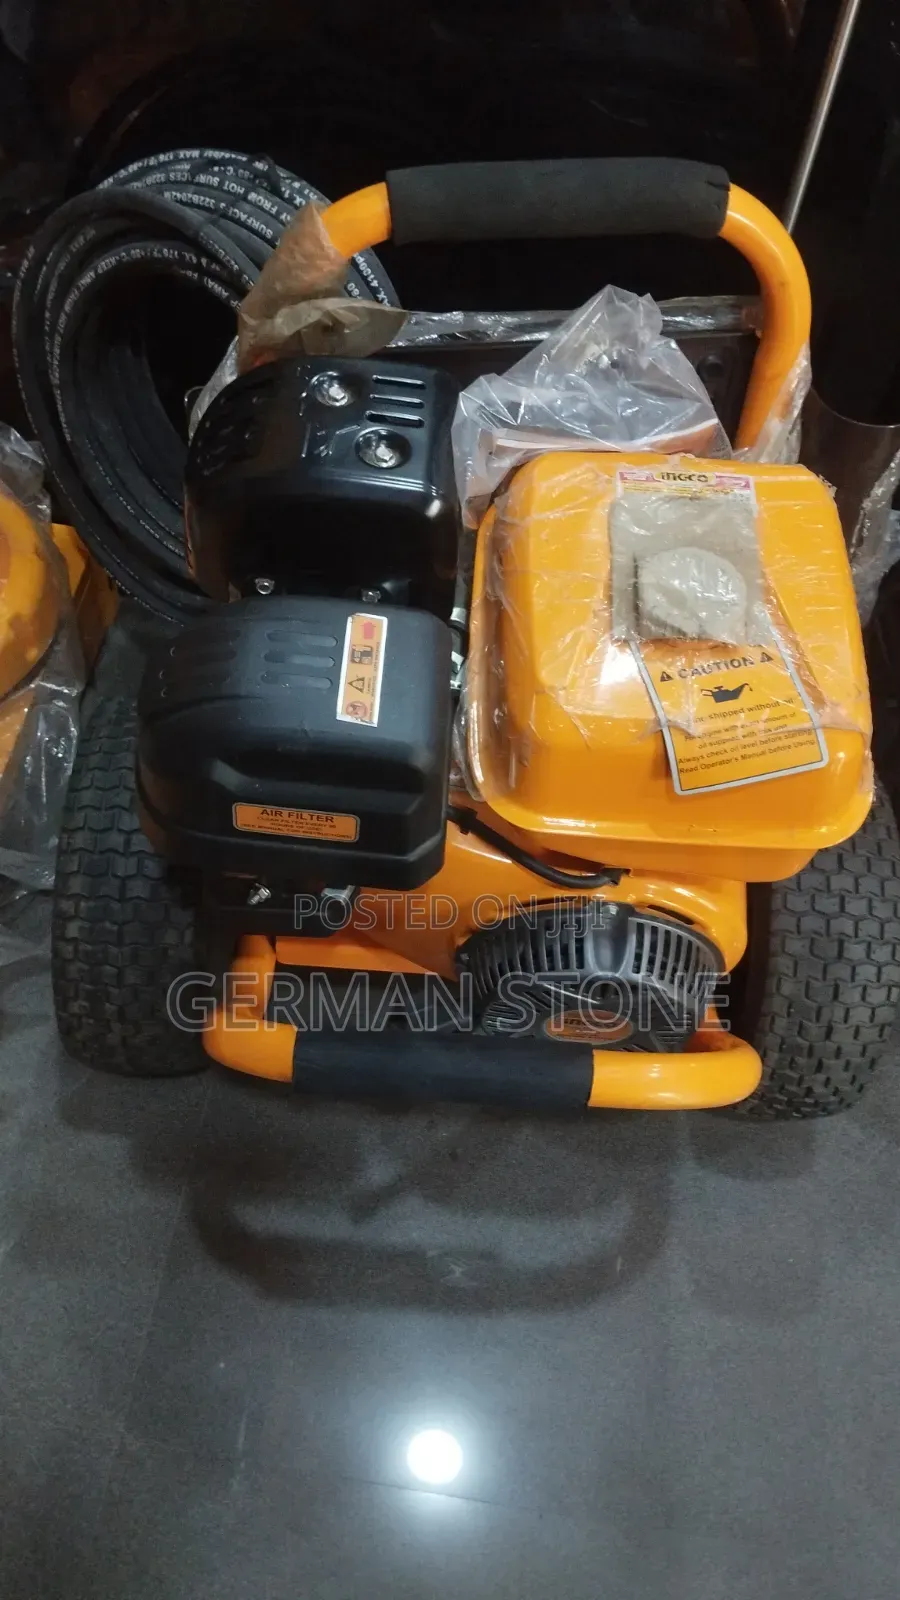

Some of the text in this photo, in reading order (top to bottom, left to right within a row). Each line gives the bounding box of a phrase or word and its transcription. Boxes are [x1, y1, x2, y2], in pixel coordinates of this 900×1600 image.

[222, 180, 246, 195] HOT
[247, 191, 279, 216] FROM
[677, 655, 756, 680] CAUTION
[708, 708, 745, 721] shipped
[747, 701, 781, 714] without
[678, 754, 705, 765] Always
[707, 748, 729, 759] check
[741, 740, 758, 751] level
[759, 734, 782, 746] before
[679, 765, 700, 775] Read
[700, 758, 739, 771] Operator's
[768, 743, 792, 755] before
[260, 809, 335, 823] AIR FILTER
